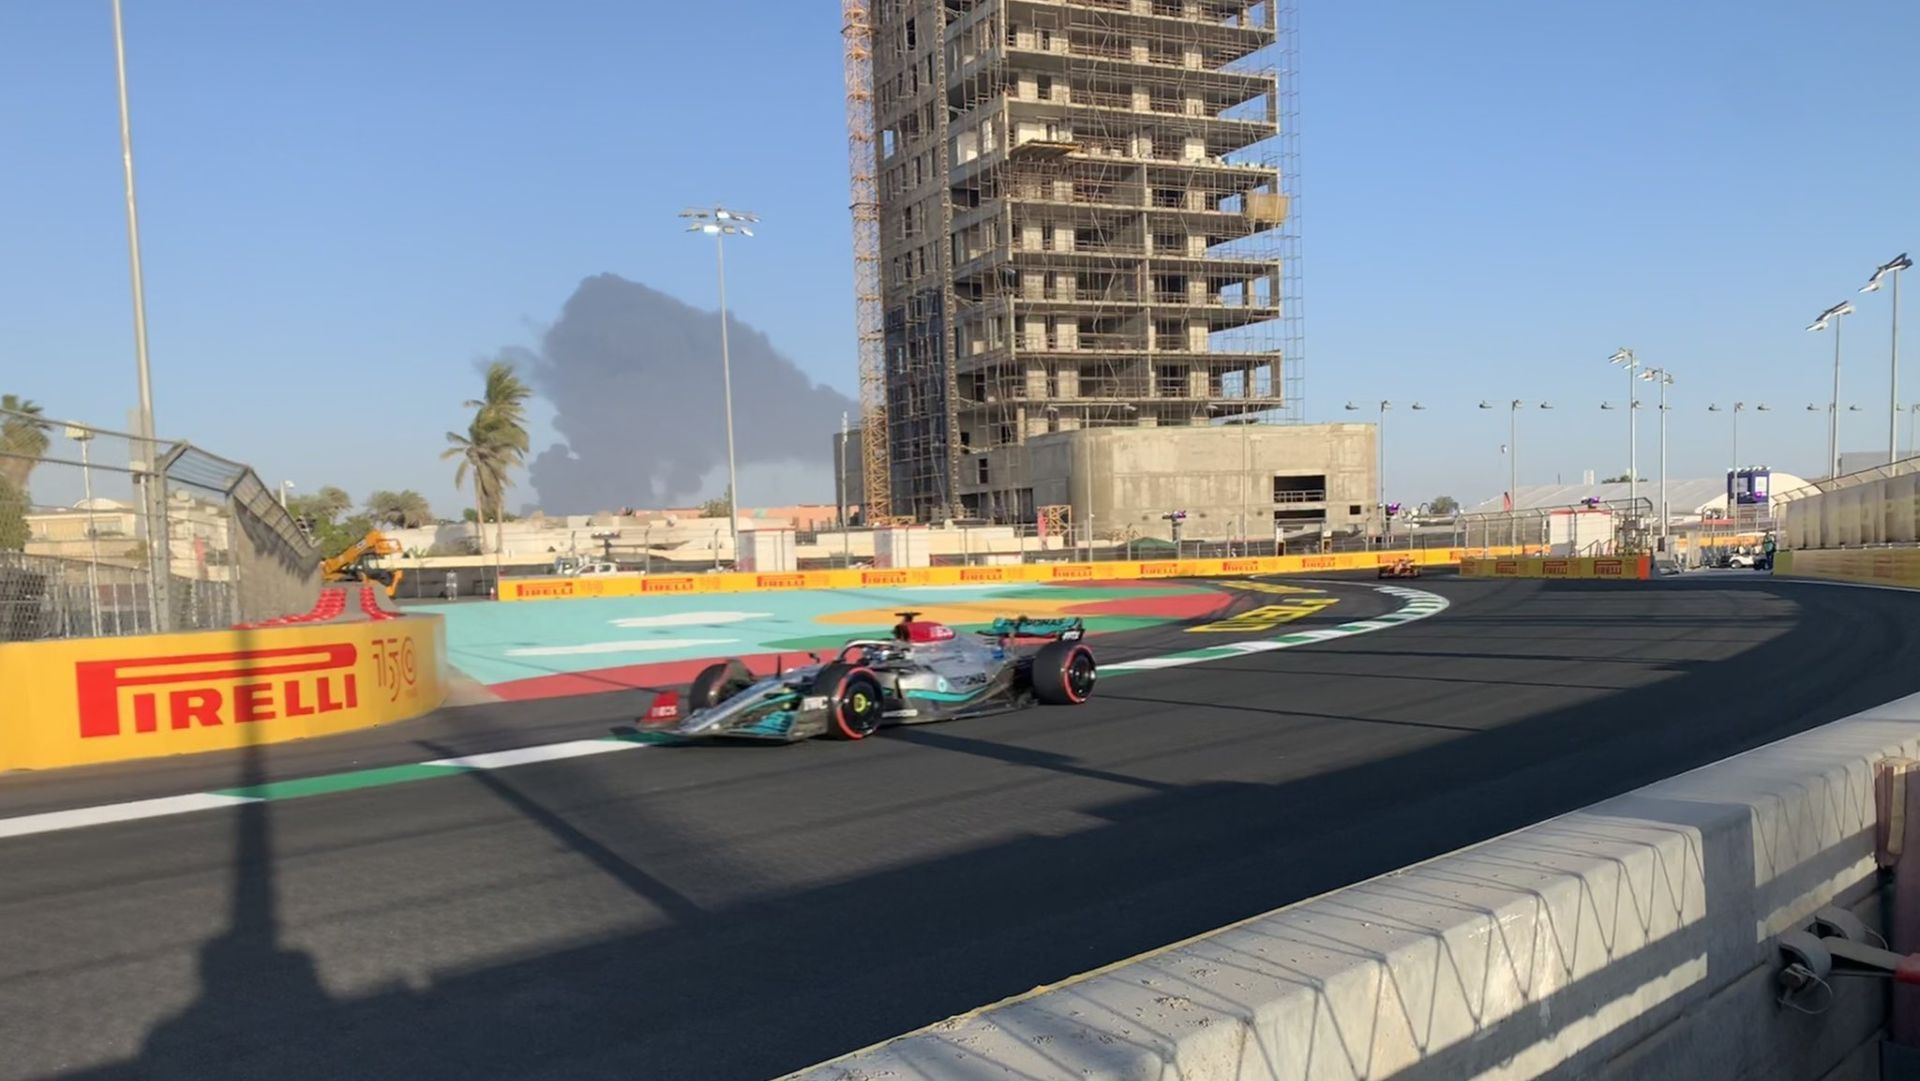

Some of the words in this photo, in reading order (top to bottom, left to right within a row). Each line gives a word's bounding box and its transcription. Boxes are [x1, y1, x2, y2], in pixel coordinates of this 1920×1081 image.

[1052, 566, 1092, 578] PIRELLI
[1140, 563, 1178, 575] PIRELLI
[1223, 561, 1259, 572] PIRELLI
[756, 574, 805, 587] PIRELLI
[861, 571, 907, 584] PIRELLI
[960, 568, 1003, 581] PIRELLI
[516, 581, 574, 597] PIRELLI
[641, 578, 694, 592] PIRELLI
[75, 642, 358, 738] PIRELLI
[371, 636, 418, 703] 150
